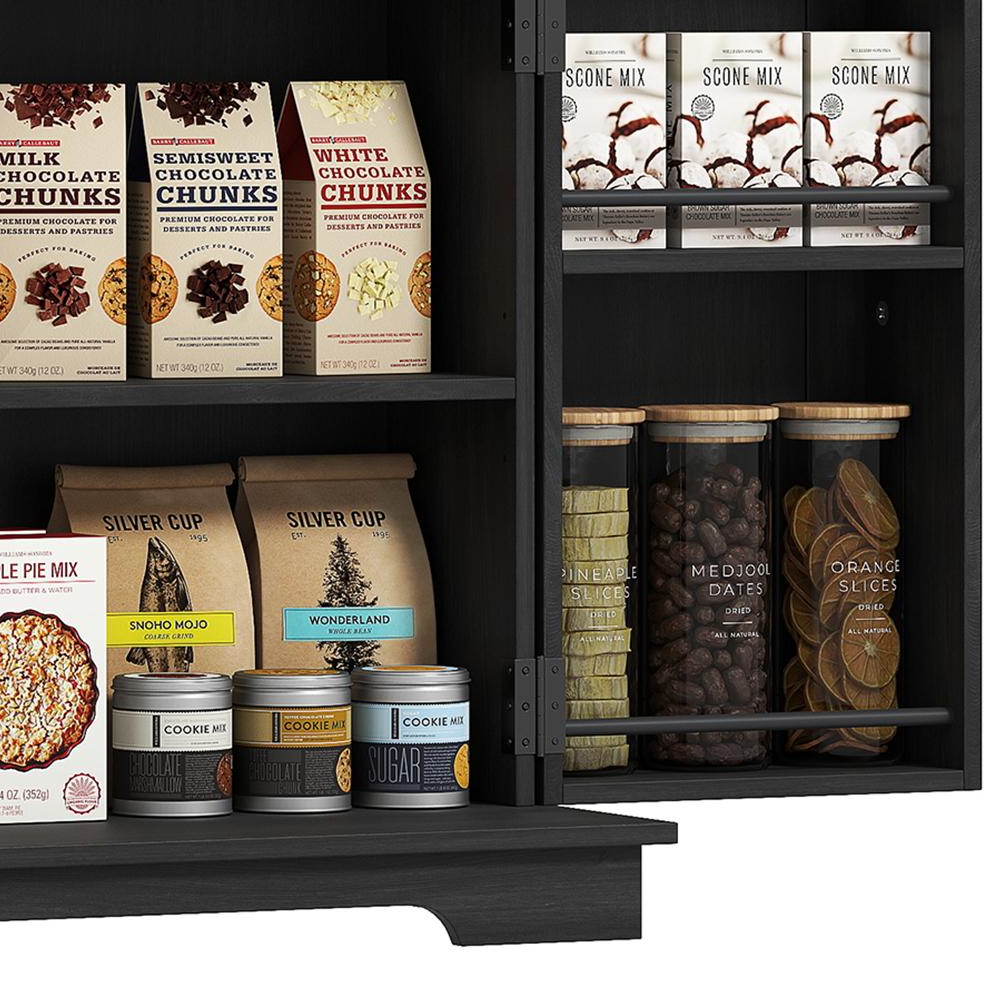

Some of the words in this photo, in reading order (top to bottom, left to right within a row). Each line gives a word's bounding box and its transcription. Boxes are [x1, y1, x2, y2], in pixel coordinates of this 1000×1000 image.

[565, 67, 612, 87] SCONE
[620, 67, 646, 87] MIX
[702, 67, 749, 87] SCONE
[756, 66, 782, 86] MIX
[831, 66, 878, 86] SCONE
[885, 65, 910, 85] MIX
[153, 152, 274, 164] SEMISWEET
[313, 148, 388, 162] WHITE
[156, 169, 276, 180] CHOCOLATE
[318, 167, 425, 178] CHOCOLATE
[156, 186, 278, 204] CHUNKS
[320, 183, 427, 201] CHUNKS
[384, 222, 421, 230] PASTRIES
[7, 366, 17, 375] WT
[19, 366, 36, 376] 340g
[38, 366, 48, 375] (12
[156, 363, 169, 372] NET
[170, 363, 179, 372] WT
[181, 363, 197, 373] 340g
[102, 515, 164, 531] SILVER
[167, 514, 204, 530] CUP
[286, 512, 347, 528] SILVER
[351, 511, 386, 527] CUP
[23, 562, 46, 579] PIE
[51, 561, 78, 578] MIX
[691, 563, 770, 578] MEDJOOL
[830, 559, 899, 574] ORANGE
[708, 583, 763, 596] DATES
[838, 578, 896, 593] SLICES
[571, 585, 630, 600] SLICES
[724, 606, 751, 614] DRIED
[129, 620, 172, 630] SNOHO
[174, 619, 208, 629] MOJO
[309, 615, 390, 625] WONDERLAND
[714, 631, 728, 639] ALL
[730, 631, 759, 639] NATURAL
[863, 626, 892, 634] NATURAL
[284, 721, 329, 731] COOKIE
[331, 719, 346, 729] MIX
[402, 717, 448, 727] COOKIE
[450, 716, 464, 726] MIX
[164, 724, 210, 734] COOKIE
[212, 723, 227, 733] MIX
[368, 745, 420, 783] SUGAR
[23, 789, 49, 801] (352g)
